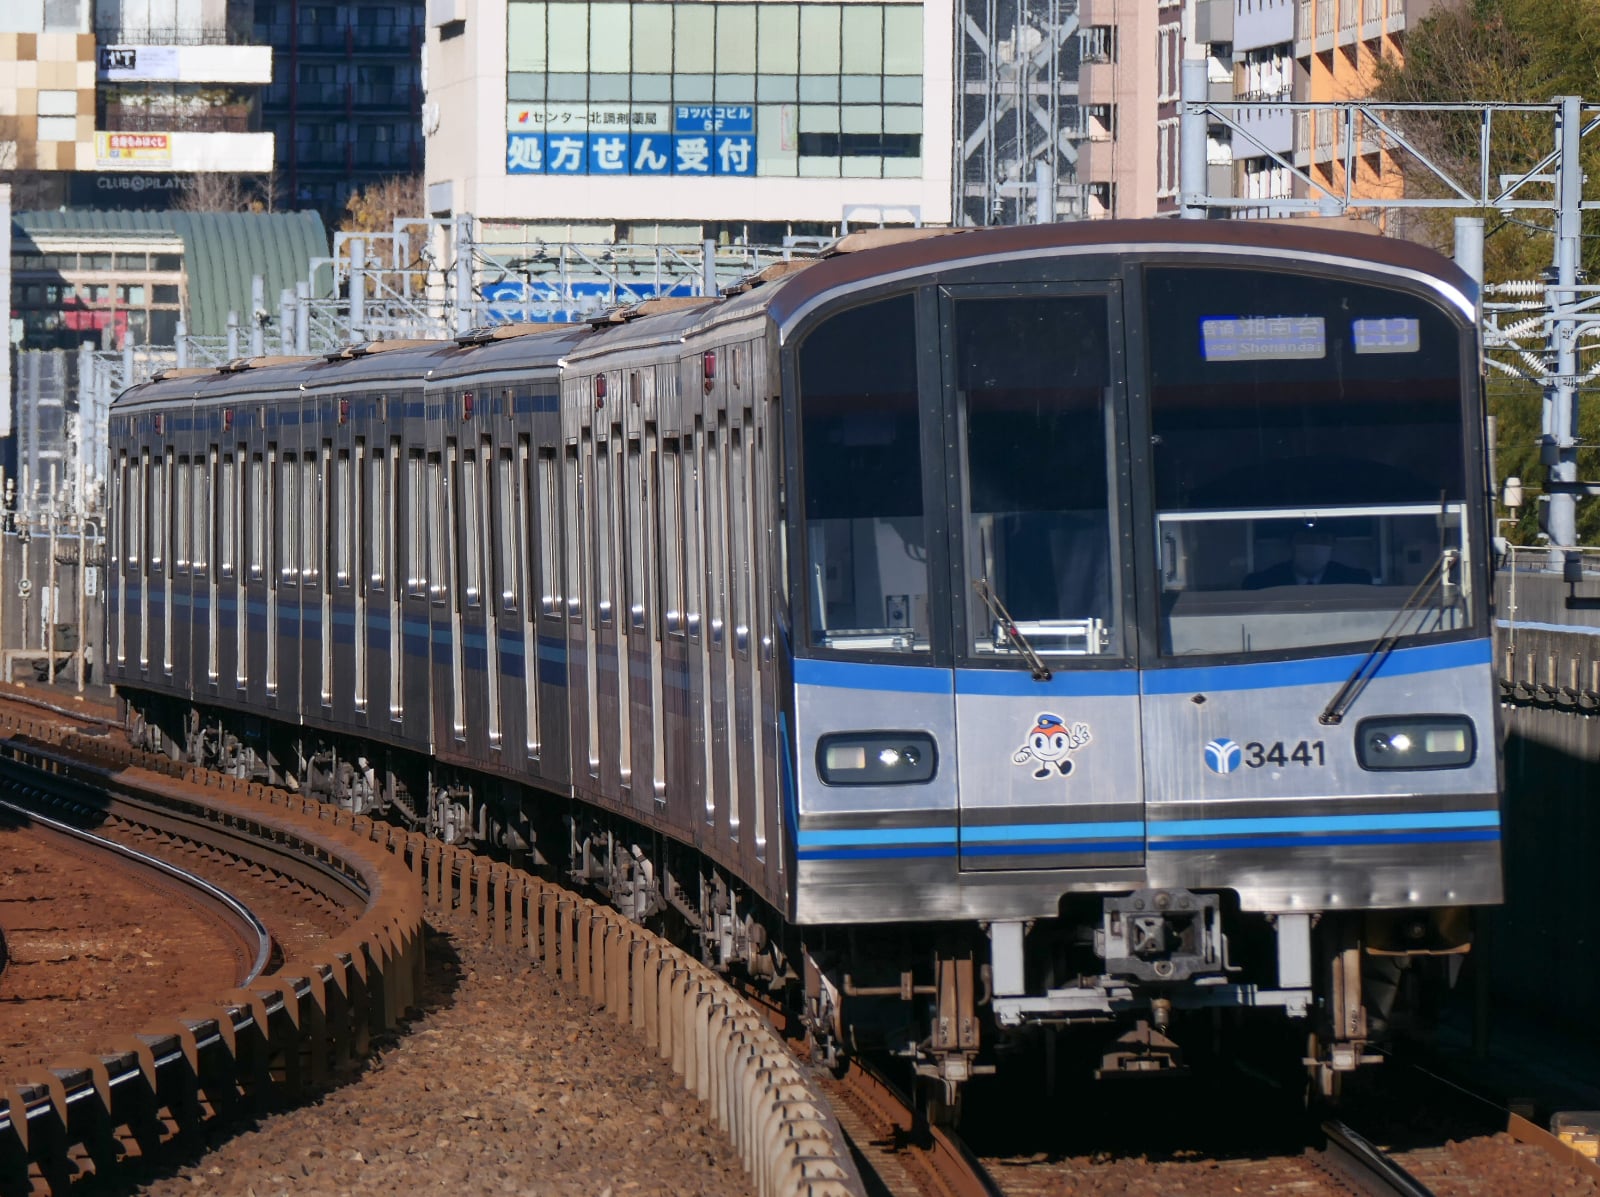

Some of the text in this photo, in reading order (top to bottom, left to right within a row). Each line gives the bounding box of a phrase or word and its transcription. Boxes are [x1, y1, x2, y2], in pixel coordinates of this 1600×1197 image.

[533, 112, 657, 125] センター北調剤薬局
[508, 136, 752, 172] 処方せん受付
[97, 176, 130, 190] CLUB
[1240, 341, 1321, 353] Shonandai
[1245, 740, 1325, 769] 3441
